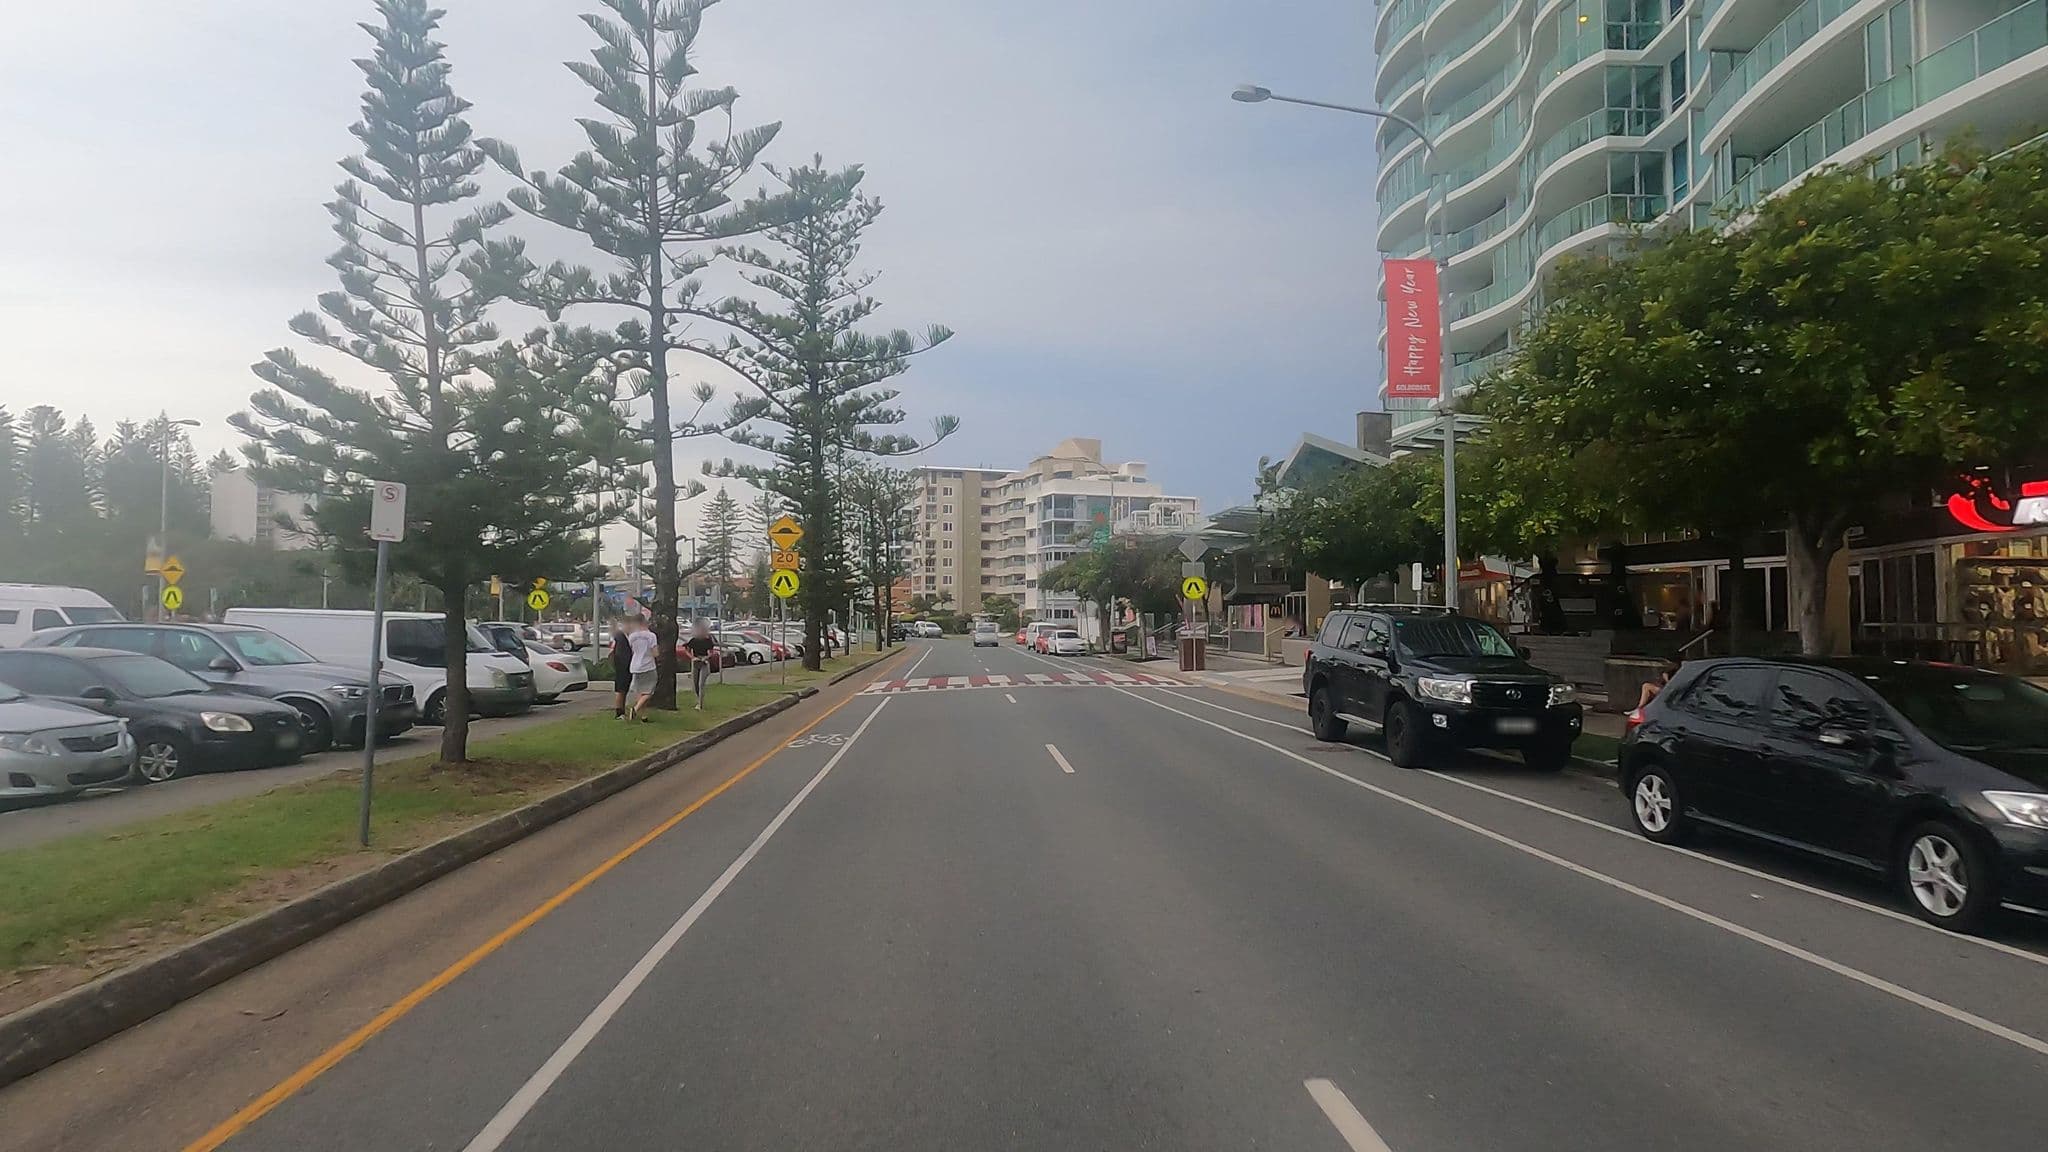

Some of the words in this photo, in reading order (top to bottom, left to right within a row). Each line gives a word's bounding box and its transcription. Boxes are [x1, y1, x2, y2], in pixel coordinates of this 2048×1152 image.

[1400, 267, 1422, 294] Year
[1402, 300, 1423, 328] New
[1403, 334, 1427, 376] Happy
[776, 553, 794, 563] 20
